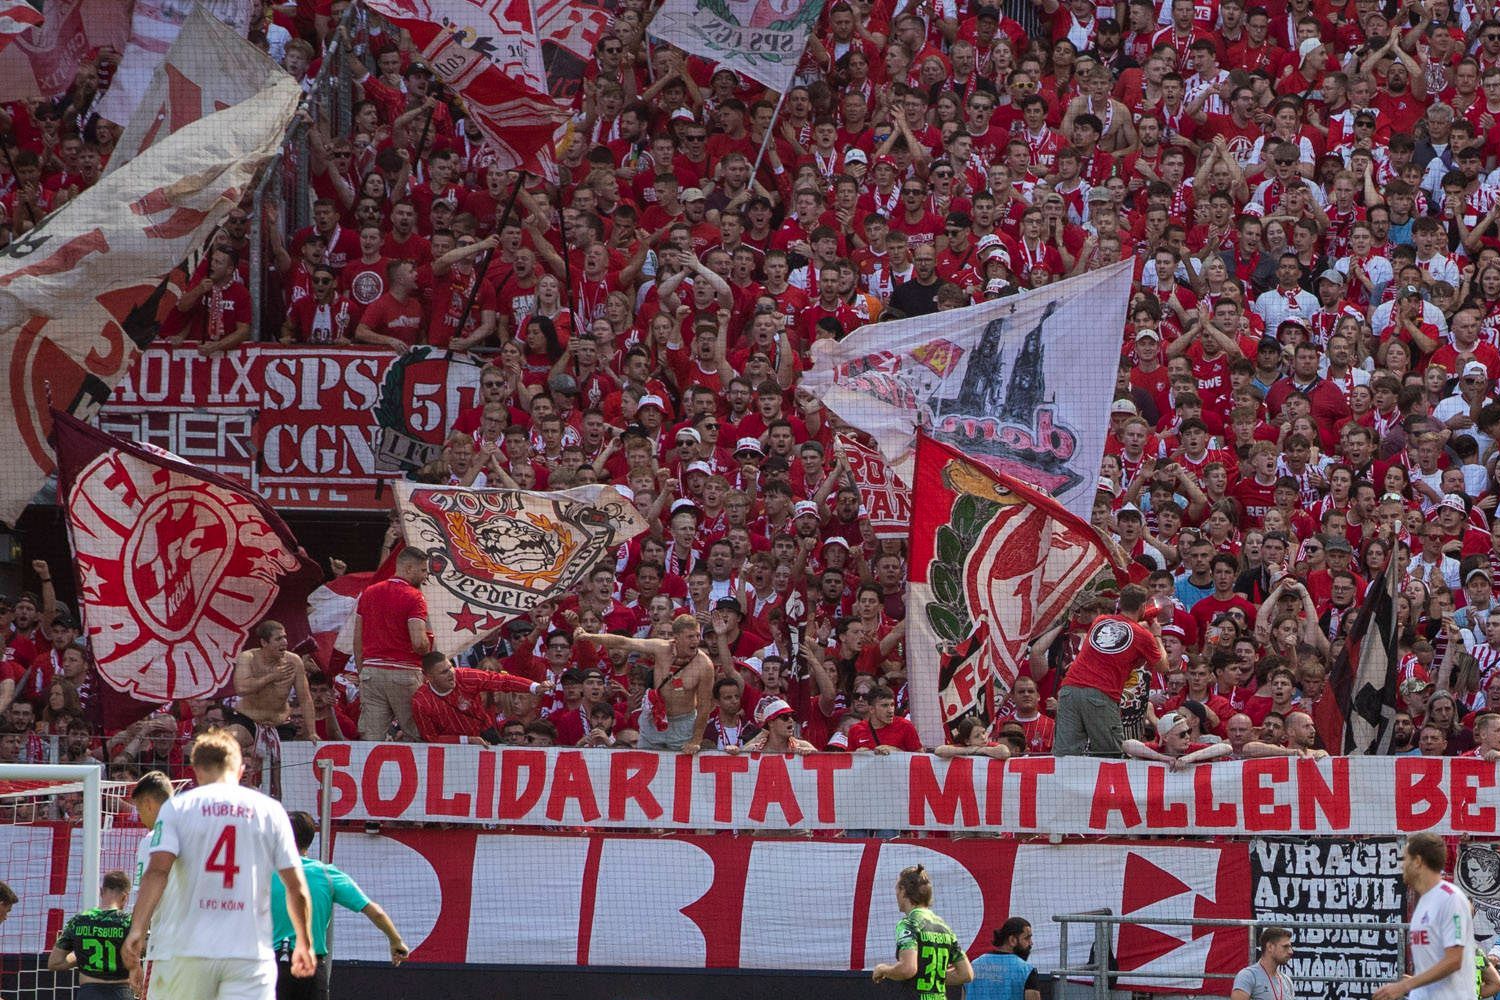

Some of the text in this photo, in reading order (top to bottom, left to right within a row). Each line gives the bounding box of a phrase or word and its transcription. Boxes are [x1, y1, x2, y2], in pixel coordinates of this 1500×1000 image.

[263, 357, 379, 411] SPS
[312, 743, 853, 827] SOLIDARITÄT
[908, 755, 1055, 828] MIT
[1089, 757, 1350, 831] ALLEN
[204, 824, 240, 889] 4
[1253, 840, 1404, 876] VIRAGE
[220, 899, 245, 911] KÖLN
[1254, 876, 1402, 910] AUTEUIL
[75, 926, 124, 938] WOLFSBURG
[82, 938, 118, 973] 31
[916, 945, 951, 994] 39
